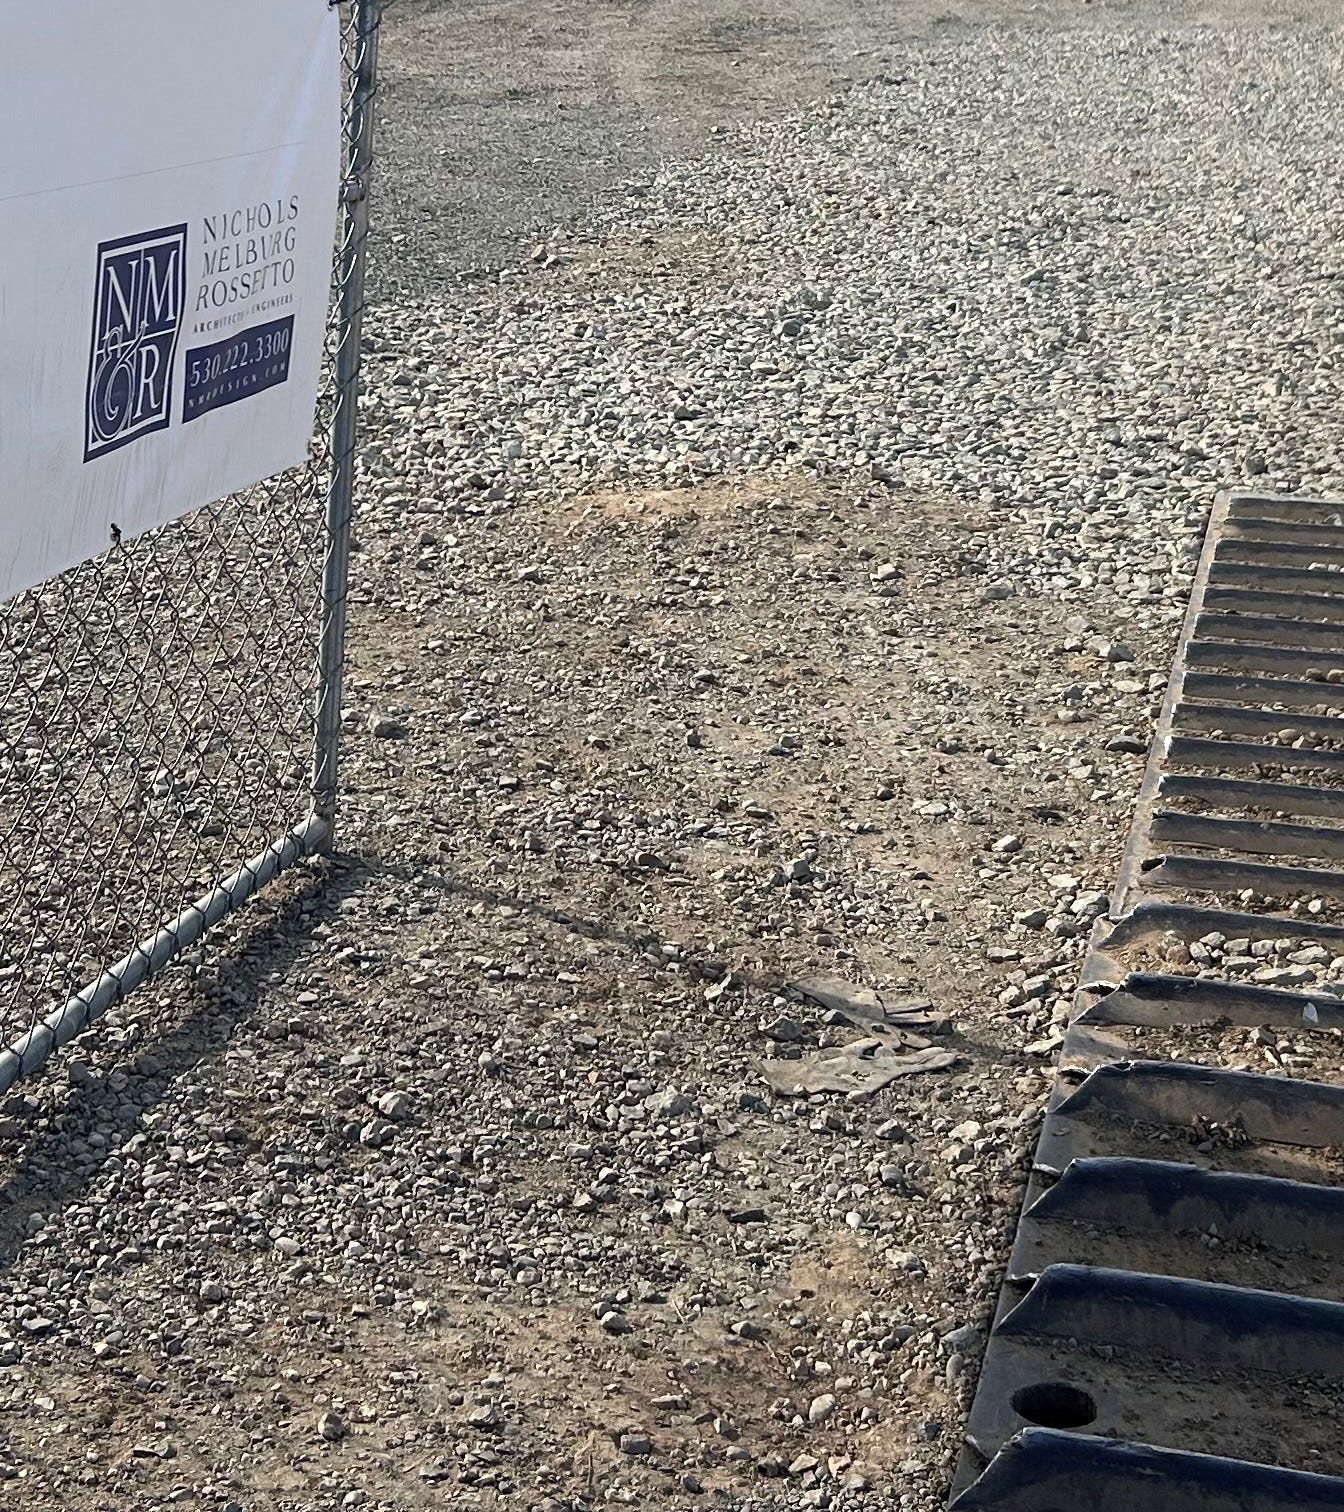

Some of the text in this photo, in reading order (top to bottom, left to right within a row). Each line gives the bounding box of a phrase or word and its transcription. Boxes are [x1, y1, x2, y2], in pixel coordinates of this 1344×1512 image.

[203, 195, 298, 244] NICHOLS
[202, 227, 296, 277] MELBURG
[195, 258, 295, 311] ROSSETTO
[190, 328, 289, 387] 530.222.3300
